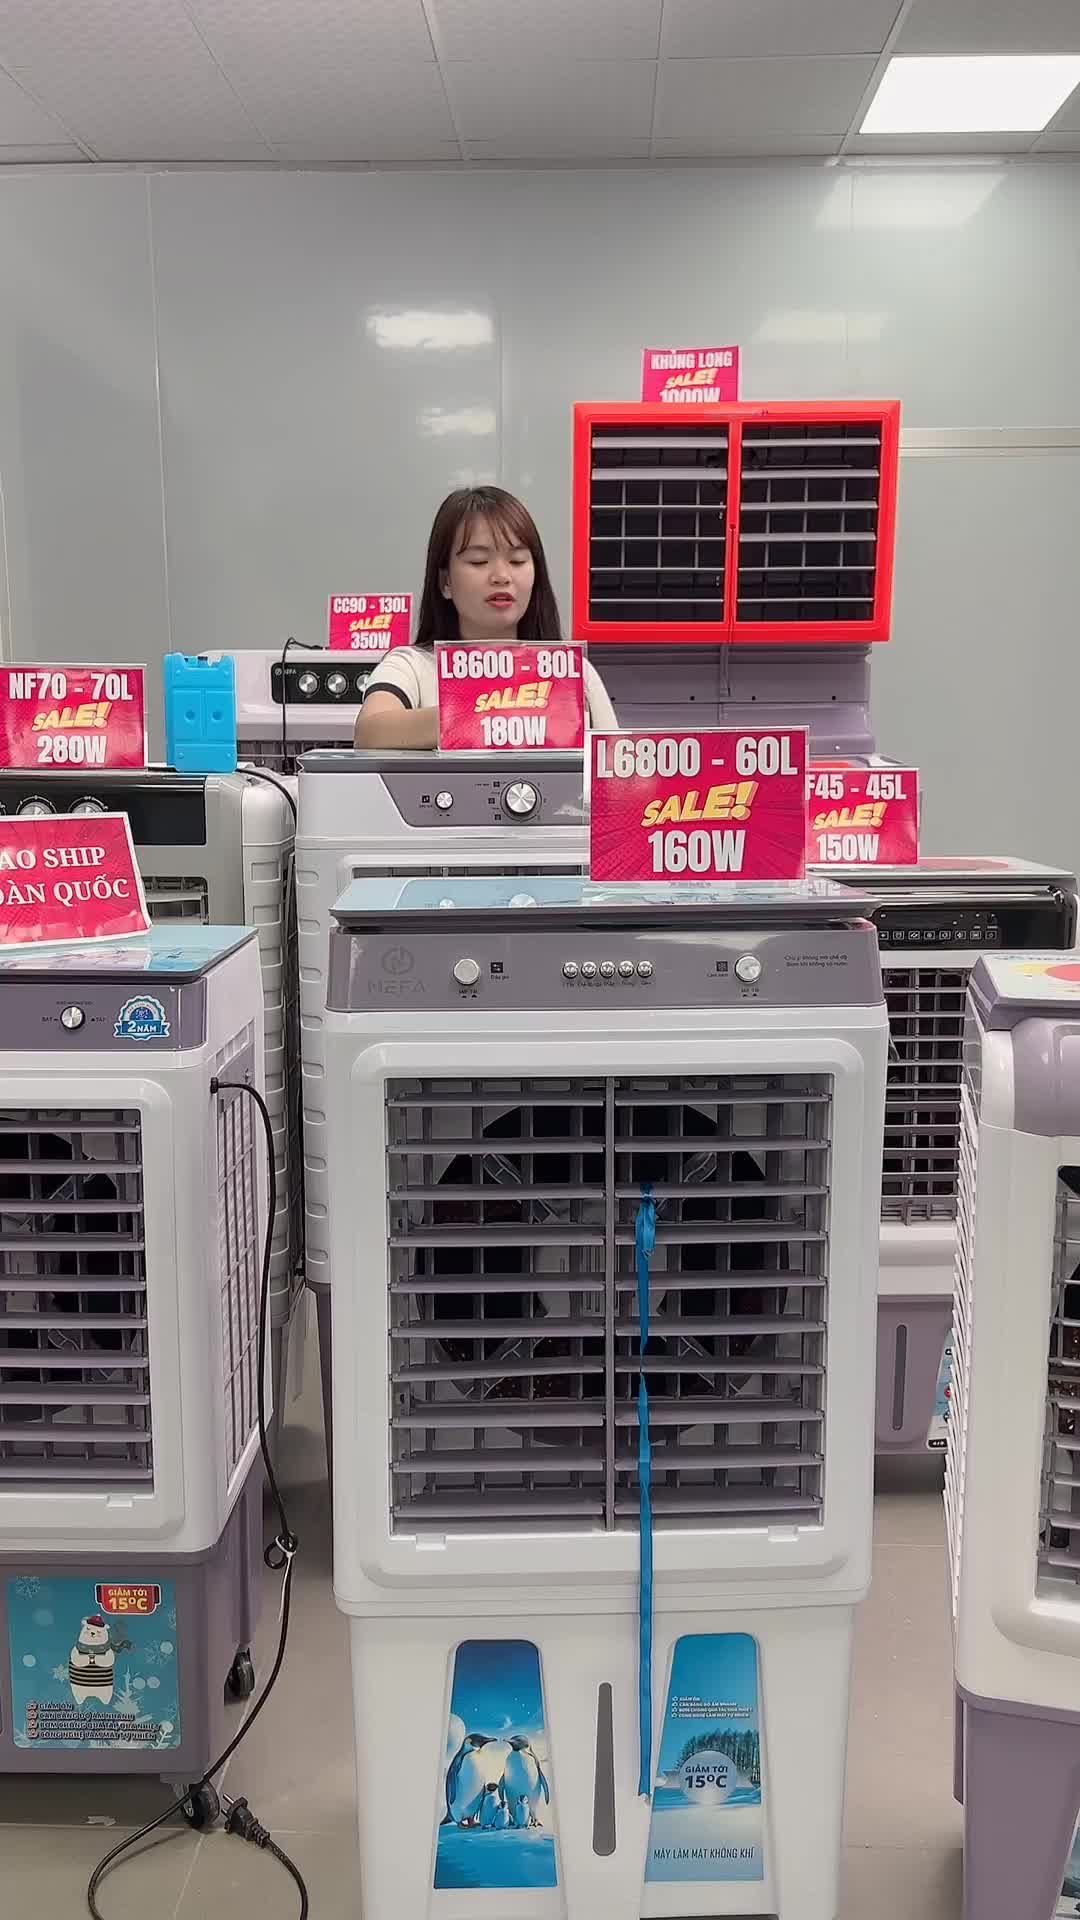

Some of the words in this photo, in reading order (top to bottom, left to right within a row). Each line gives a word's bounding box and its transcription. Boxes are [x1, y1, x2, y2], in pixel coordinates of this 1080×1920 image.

[698, 351, 733, 368] LONG
[665, 368, 718, 389] SALE!
[333, 598, 367, 613] CC90
[378, 597, 408, 613] 130L
[349, 614, 393, 631] SALE!
[351, 632, 392, 649] 350W
[440, 650, 514, 679] L8600
[537, 650, 581, 679] 80L
[9, 672, 66, 699] NF70
[91, 673, 133, 700] 70L
[474, 681, 553, 713] SALE!
[32, 702, 112, 731] SALE!
[481, 716, 546, 746] 180W
[37, 735, 107, 763] 280W
[596, 737, 700, 778] L6800
[736, 736, 798, 775] 60L
[865, 773, 906, 800] 45L
[641, 781, 759, 827] SALE!
[813, 801, 887, 830] SALE!
[43, 847, 106, 868] SHIP
[647, 829, 745, 873] 160W
[816, 834, 879, 862] 150W
[0, 880, 45, 905] ÀN
[54, 874, 130, 907] QUỐC
[128, 1020, 137, 1033] 2
[108, 1587, 131, 1597] GIẢM
[685, 1764, 710, 1773] GIẢM
[711, 1765, 728, 1773] TỚI
